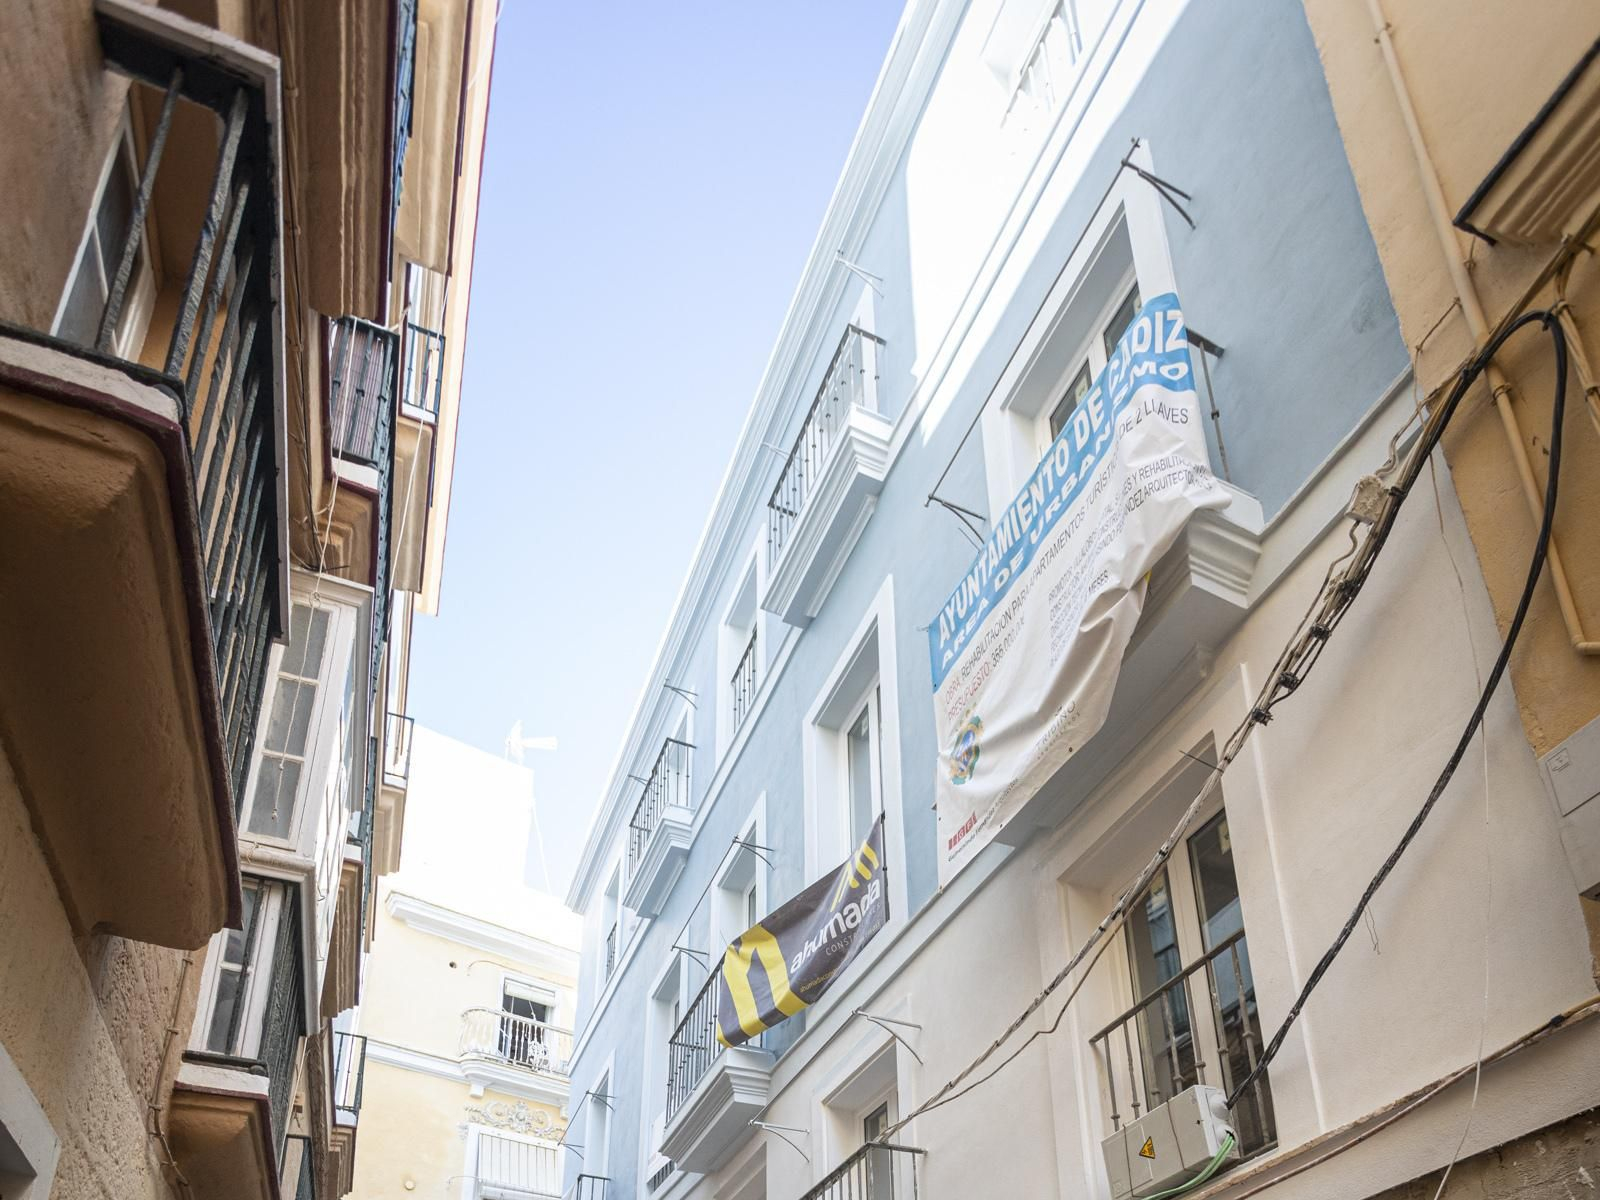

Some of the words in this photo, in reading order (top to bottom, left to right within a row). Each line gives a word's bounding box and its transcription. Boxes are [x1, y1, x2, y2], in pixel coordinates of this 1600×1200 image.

[1119, 415, 1133, 441] DE
[1135, 407, 1143, 425] 2
[938, 437, 1070, 650] AYUNTAMIENTO
[1072, 387, 1104, 452] DE
[994, 547, 1025, 593] DE
[789, 878, 881, 975] ahumada
